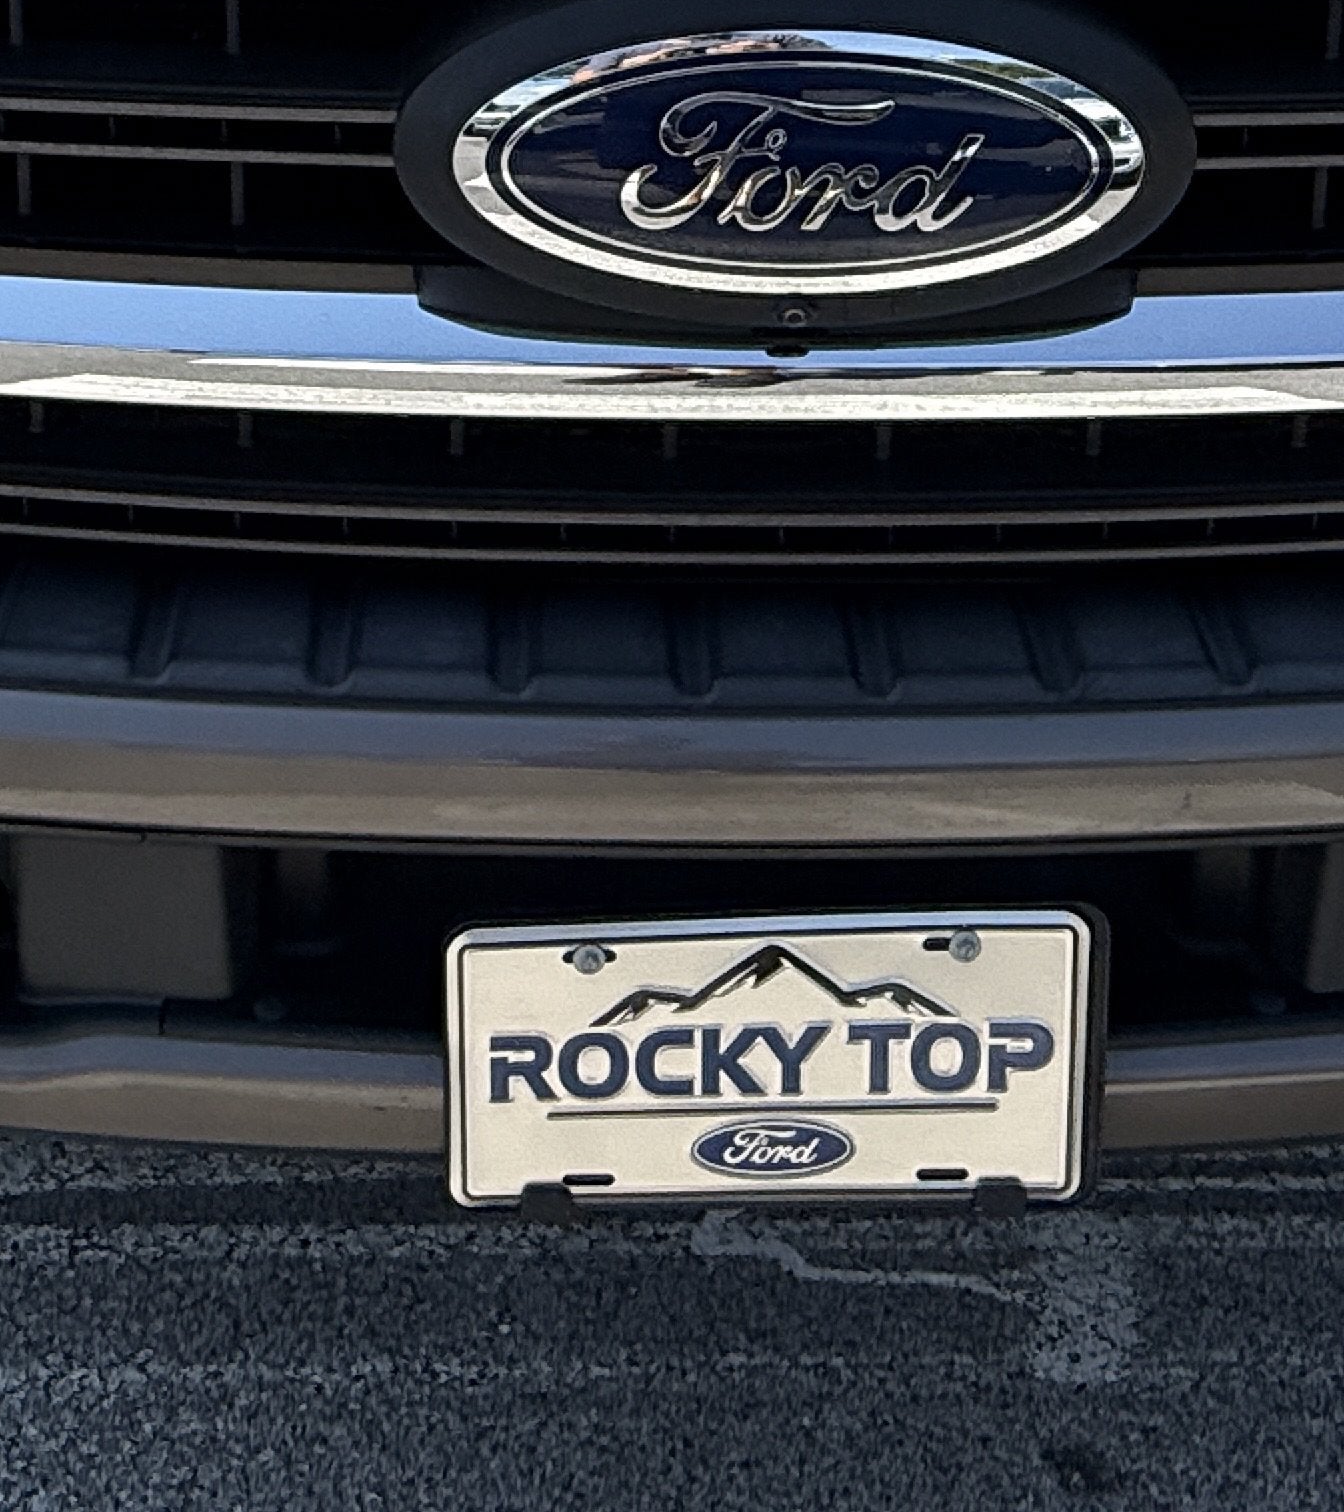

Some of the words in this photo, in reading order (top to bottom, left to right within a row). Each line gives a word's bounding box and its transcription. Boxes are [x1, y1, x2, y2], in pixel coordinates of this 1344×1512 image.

[620, 90, 985, 232] Ford
[488, 1023, 832, 1104] ROCKY
[847, 1016, 1057, 1096] TOP
[722, 1126, 819, 1167] Ford
